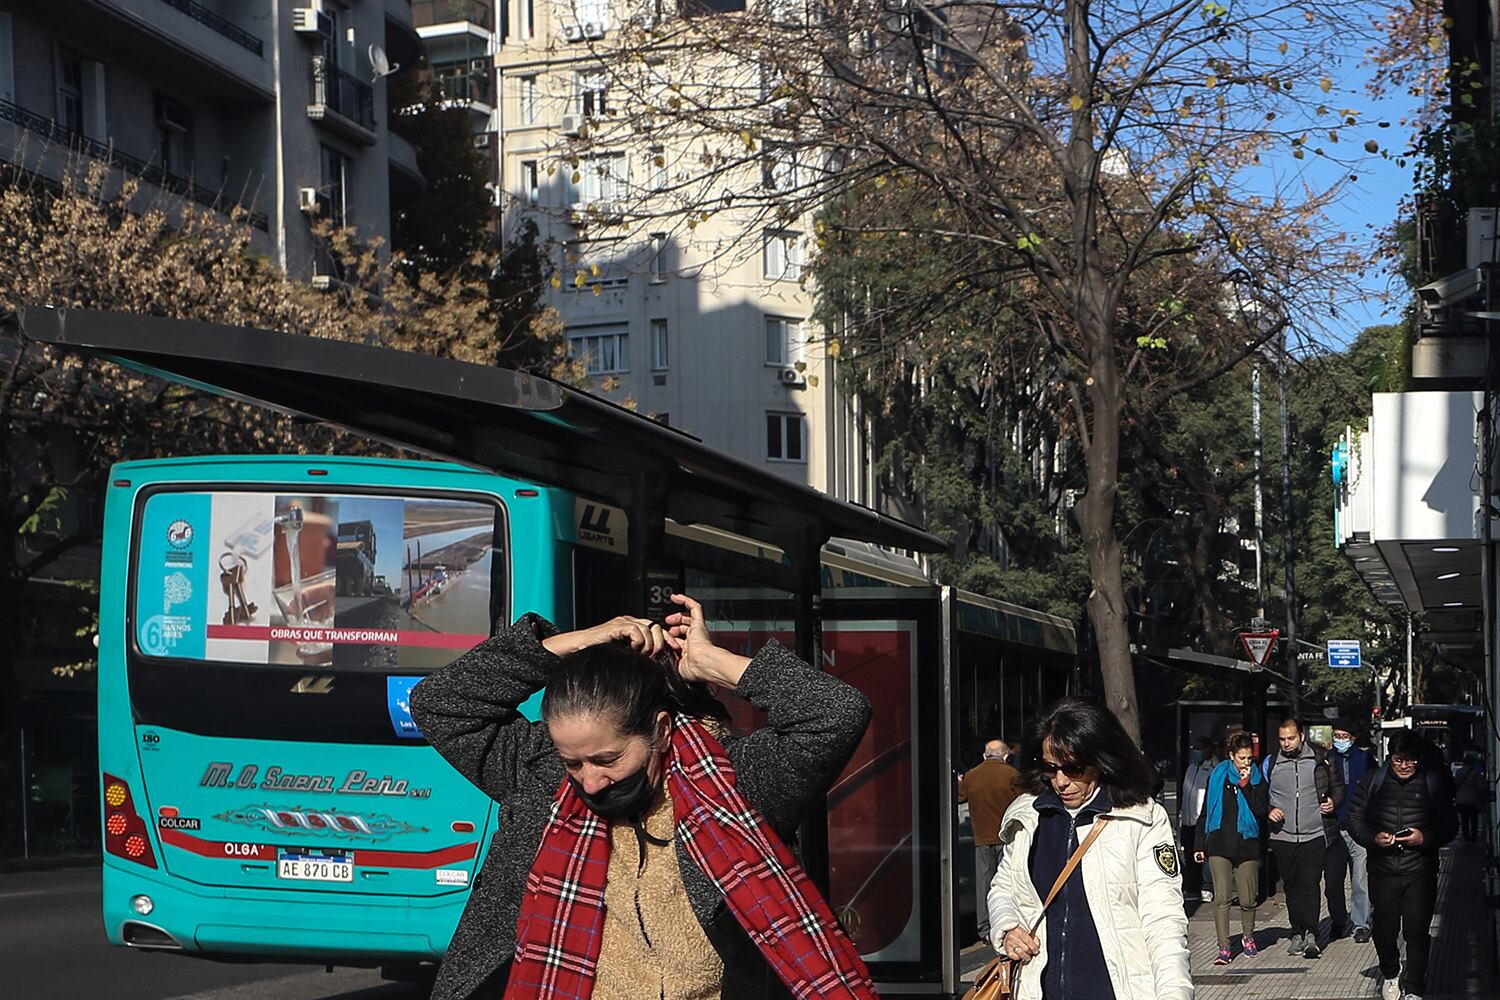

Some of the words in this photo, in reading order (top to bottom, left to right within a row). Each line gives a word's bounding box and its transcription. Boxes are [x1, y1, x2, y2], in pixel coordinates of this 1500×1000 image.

[271, 628, 301, 640] OBRAS
[303, 629, 323, 641] QUE
[324, 630, 398, 642] TRANSFORMAN
[143, 734, 160, 743] ISO
[200, 762, 258, 789] M.O.
[337, 770, 409, 797] Peña
[160, 817, 198, 829] COLCAR
[224, 842, 259, 856] OLGA
[283, 862, 299, 876] AE
[304, 863, 328, 878] 870
[333, 864, 349, 878] CB
